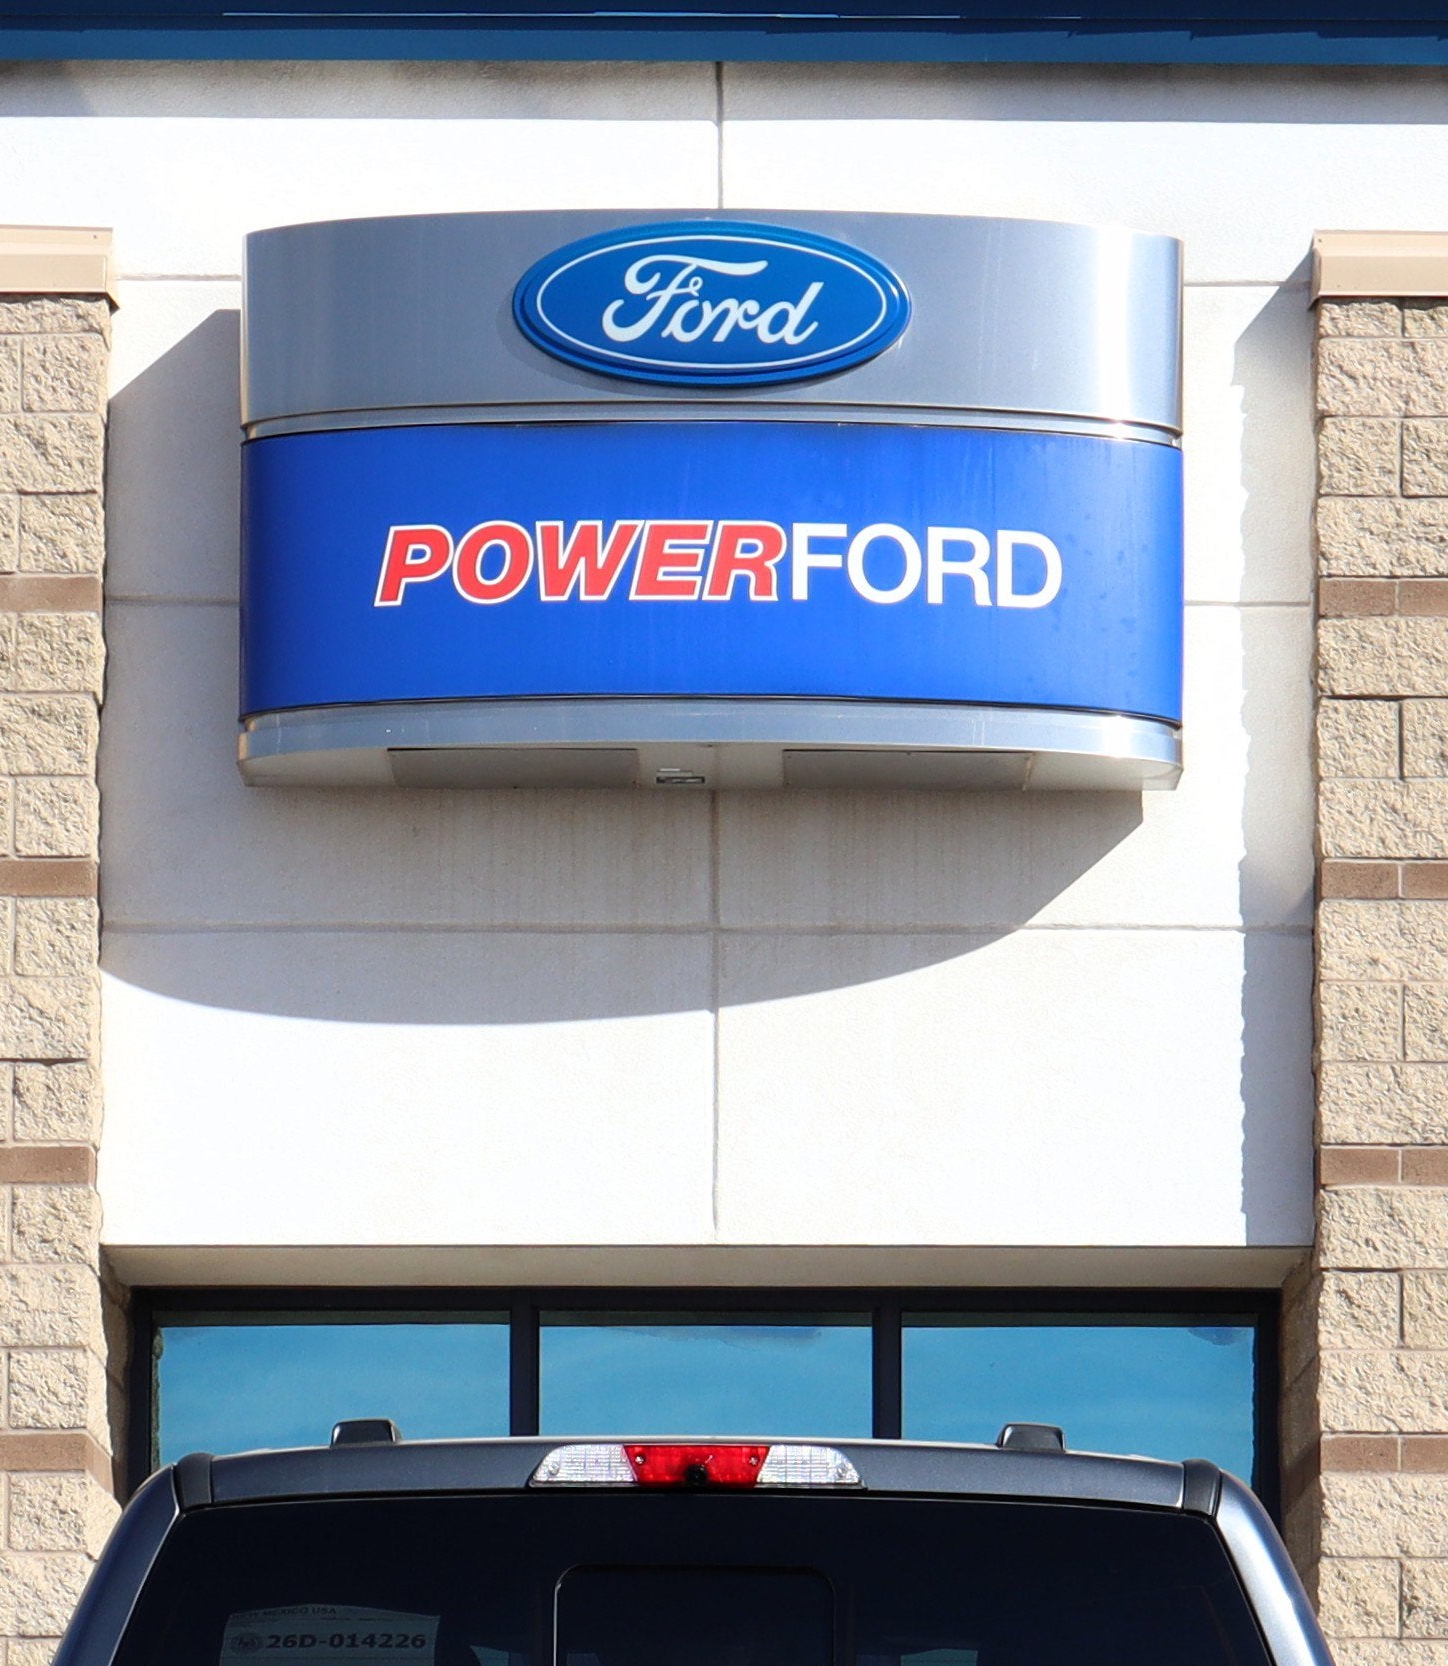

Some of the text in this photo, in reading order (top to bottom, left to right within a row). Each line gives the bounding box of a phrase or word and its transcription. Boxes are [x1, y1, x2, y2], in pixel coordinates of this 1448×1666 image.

[601, 254, 823, 346] Ford
[373, 519, 1063, 608] POWERFORD
[266, 1633, 427, 1649] 26D-014226
